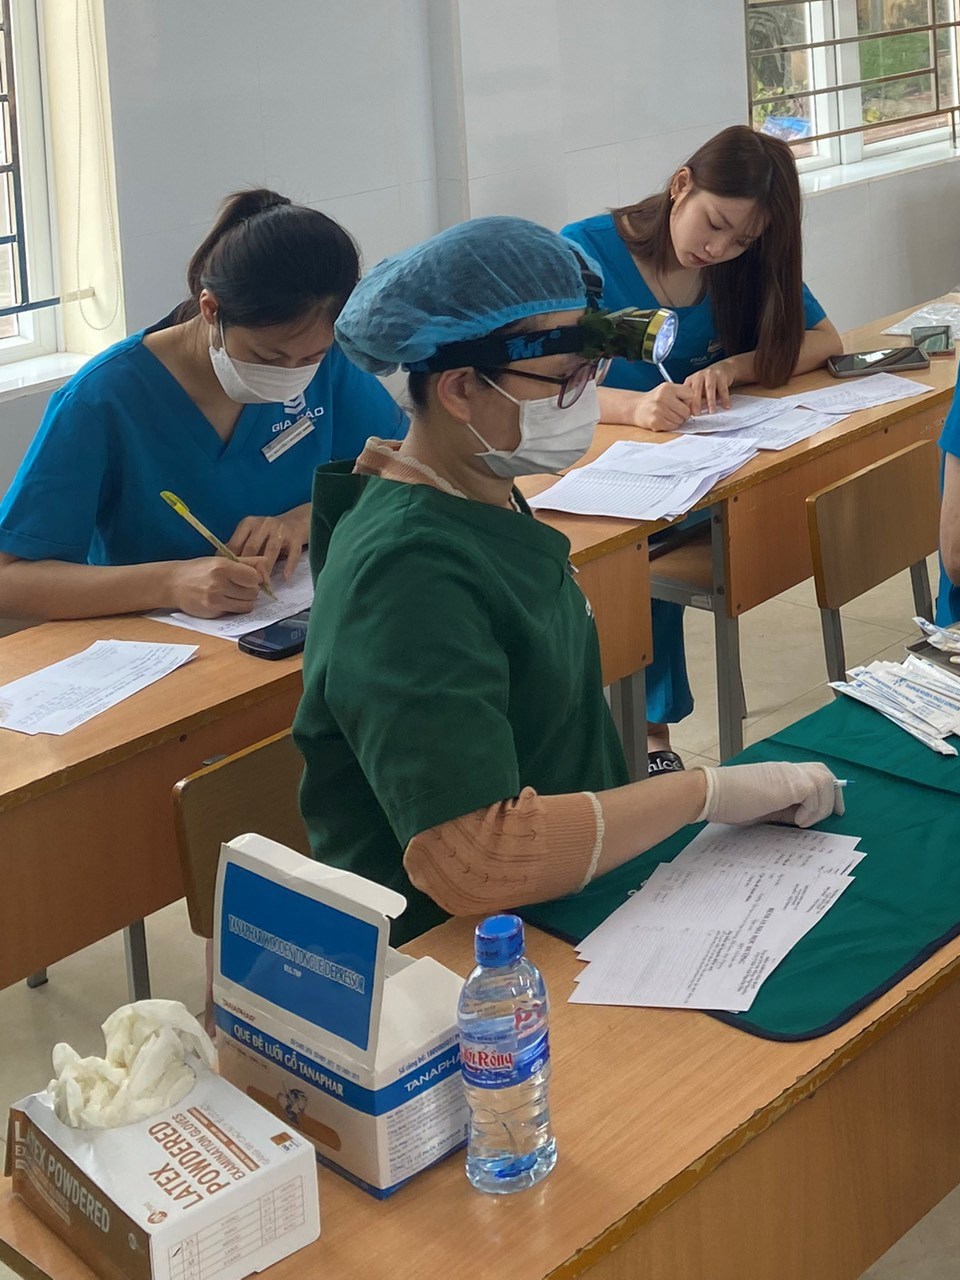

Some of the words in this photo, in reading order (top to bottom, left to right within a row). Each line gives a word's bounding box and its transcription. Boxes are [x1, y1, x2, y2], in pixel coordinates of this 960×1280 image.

[271, 420, 292, 432] GIA
[325, 958, 366, 995] DEPRESSOR
[233, 1024, 250, 1042] QUE
[252, 1034, 264, 1050] ĐÈ
[284, 1051, 298, 1070] GỖ
[299, 1061, 344, 1097] TANAPHAR
[404, 1053, 461, 1093] TANAPHA
[172, 1113, 201, 1141] GLOVES
[148, 1121, 231, 1195] POWDERED
[196, 1136, 246, 1181] EXAMINATION
[47, 1153, 111, 1233] POWDERED
[148, 1162, 204, 1210] LATEX
